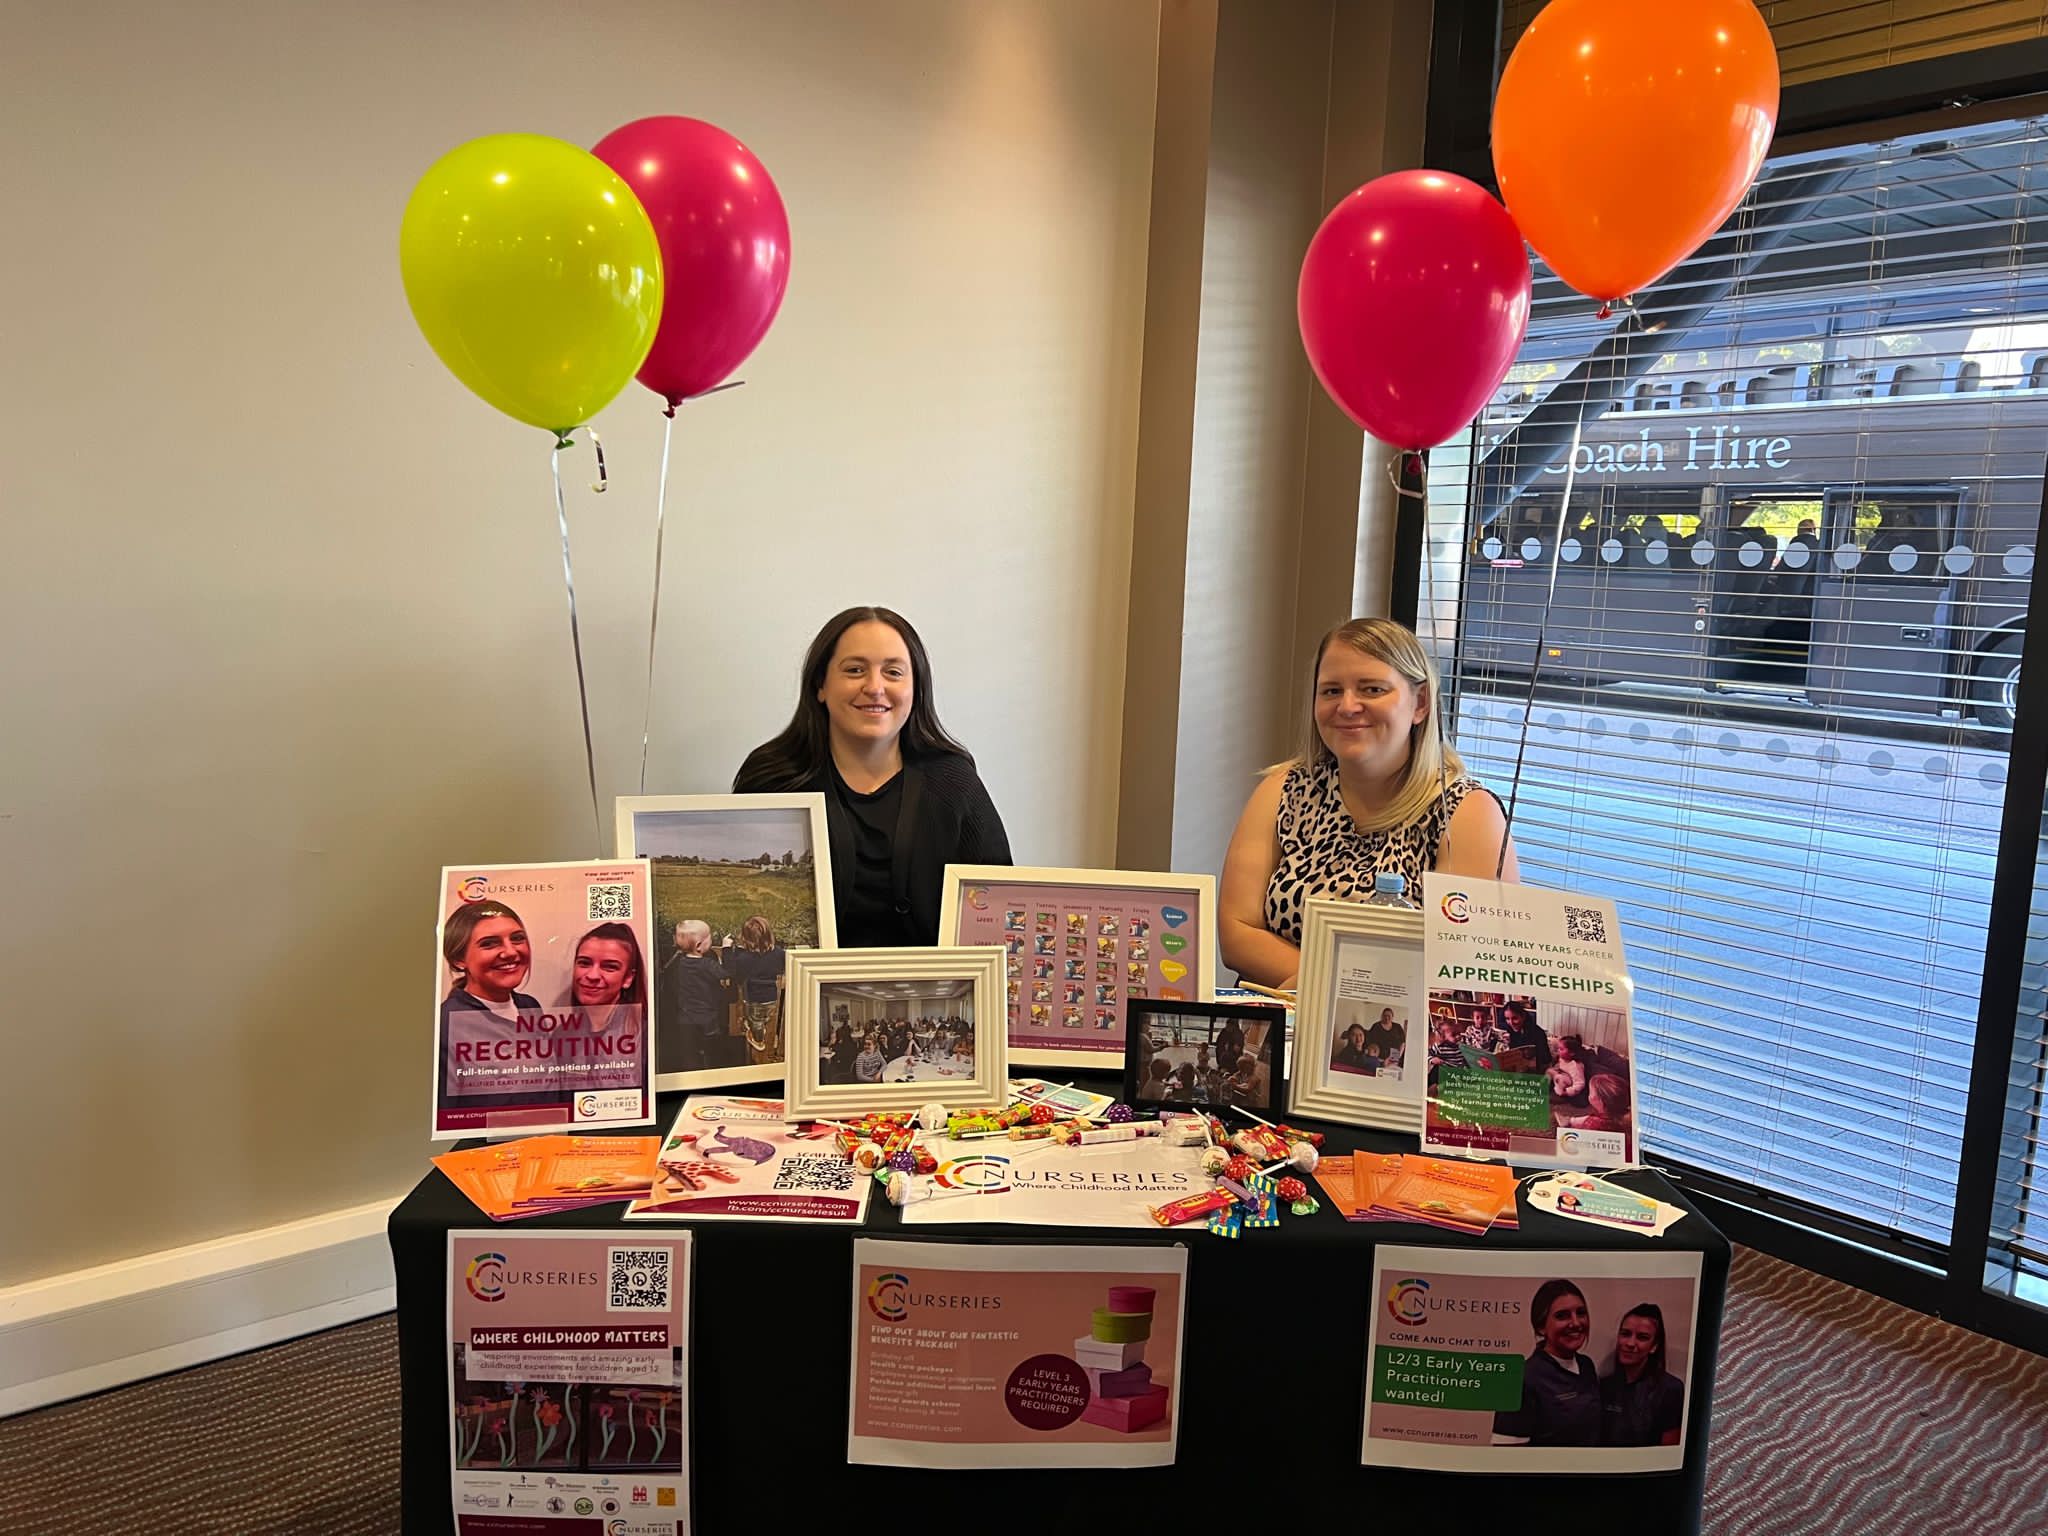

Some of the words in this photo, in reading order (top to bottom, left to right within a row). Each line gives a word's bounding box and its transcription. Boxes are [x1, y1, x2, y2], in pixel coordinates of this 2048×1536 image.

[1682, 425, 1792, 471] Hire
[476, 883, 555, 893] NURSERIES
[1458, 902, 1531, 921] NURSERIES
[1437, 932, 1467, 942] START
[1472, 935, 1500, 945] YOUR
[1503, 939, 1534, 950] EARLY
[1538, 943, 1571, 955] YEARS
[1575, 948, 1613, 960] CAREER
[1475, 952, 1496, 961] ASK
[1500, 955, 1513, 963] US
[1517, 956, 1552, 967] ABOUT
[1557, 961, 1579, 970] OUR
[1438, 964, 1615, 995] APPRENTICESHIPS
[515, 1013, 584, 1033] NOW
[455, 1034, 636, 1063] RECRUITING
[457, 1068, 498, 1076] Full-time
[502, 1066, 519, 1074] and
[523, 1065, 545, 1073] bank
[549, 1064, 591, 1073] positions
[594, 1061, 635, 1069] available
[589, 1101, 638, 1109] NURSERIES
[1461, 1098, 1491, 1107] learning
[985, 1170, 1187, 1183] NURSERIES
[1012, 1182, 1052, 1190] Where
[1061, 1183, 1131, 1192] Childhood
[1136, 1184, 1188, 1192] Matters
[728, 1200, 849, 1210] www.ccnurseries.com
[728, 1205, 847, 1216] fb.com/ccnurseriesuk
[491, 1271, 598, 1285] NURSERIES
[893, 1292, 1000, 1309] NURSERIES
[1414, 1297, 1521, 1314] NURSERIES
[473, 1333, 517, 1344] WHERE
[524, 1332, 600, 1343] CHILDHOOD
[605, 1331, 666, 1342] MATTERS
[872, 1325, 891, 1334] FIND
[895, 1328, 912, 1336] OUT
[917, 1328, 947, 1338] ABOUT
[971, 1332, 1019, 1340] FANTASTIC
[872, 1336, 912, 1346] BENEFITS
[916, 1340, 957, 1349] PACKAGE!
[1390, 1333, 1419, 1343] COME
[1423, 1335, 1445, 1345] AND
[1449, 1337, 1474, 1347] CHAT
[1479, 1338, 1491, 1347] TO
[1495, 1339, 1510, 1348] US!
[598, 1356, 632, 1364] amazing
[636, 1356, 655, 1364] early
[1388, 1352, 1420, 1367] L2/3
[1427, 1356, 1462, 1372] Early
[1468, 1359, 1506, 1373] Years
[524, 1363, 572, 1372] experiences
[576, 1363, 587, 1371] for
[590, 1364, 623, 1372] children
[626, 1365, 647, 1374] aged
[1034, 1368, 1062, 1381] LEVEL
[1019, 1378, 1048, 1388] EARLY
[1050, 1383, 1080, 1394] YEARS
[1388, 1370, 1481, 1388] Practitioners
[1010, 1387, 1084, 1406] PRACTITIONERS
[1386, 1389, 1444, 1403] wanted!
[1021, 1400, 1069, 1414] REQUIRED
[1382, 1426, 1478, 1440] www.ccnurseries.com
[619, 1526, 673, 1534] NURSERIES
